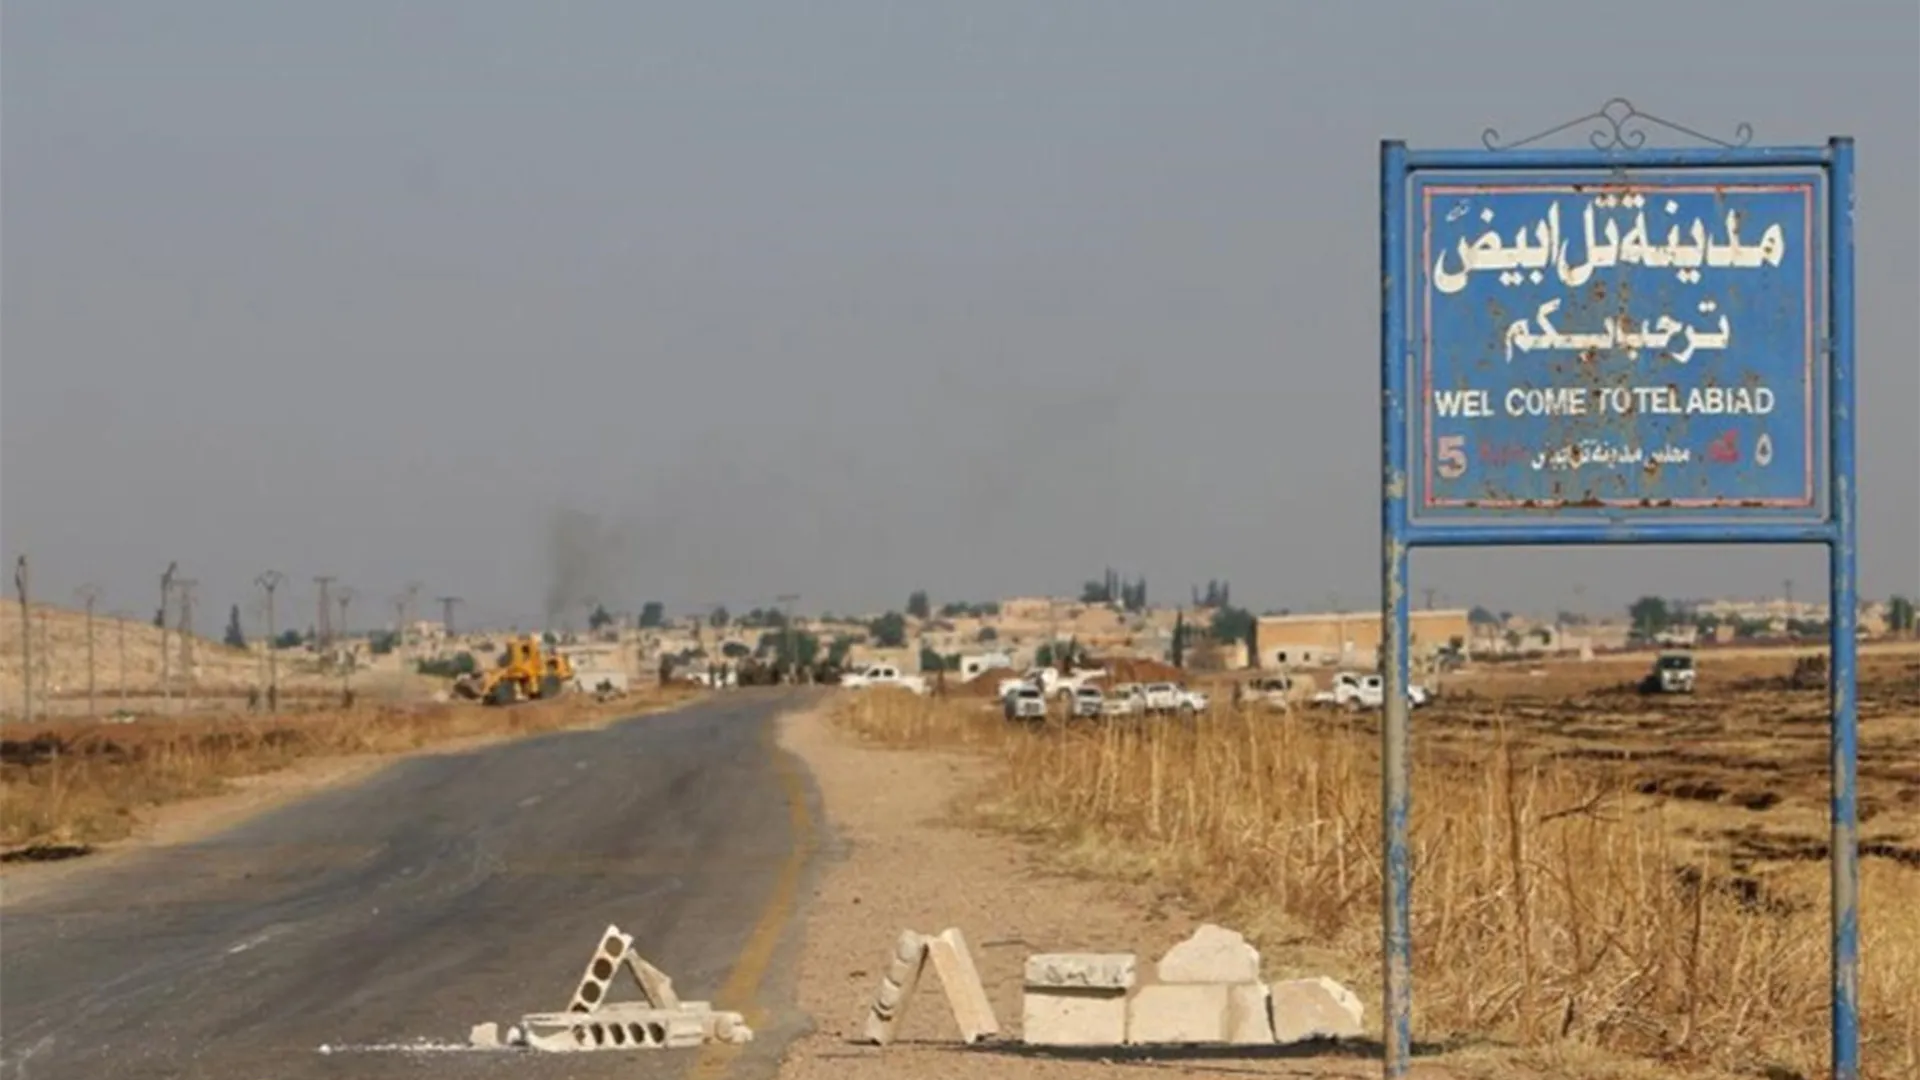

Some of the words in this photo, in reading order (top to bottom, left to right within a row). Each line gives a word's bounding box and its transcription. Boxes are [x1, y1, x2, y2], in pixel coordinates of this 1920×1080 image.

[1433, 200, 1560, 294] ابيض
[1556, 193, 1620, 287] تل
[1619, 194, 1785, 285] مدينة
[1504, 298, 1615, 364] بكم
[1616, 299, 1730, 364] ترحب
[1504, 387, 1588, 417] COME
[1685, 387, 1776, 415] ABIAD
[1437, 435, 1467, 477] 5
